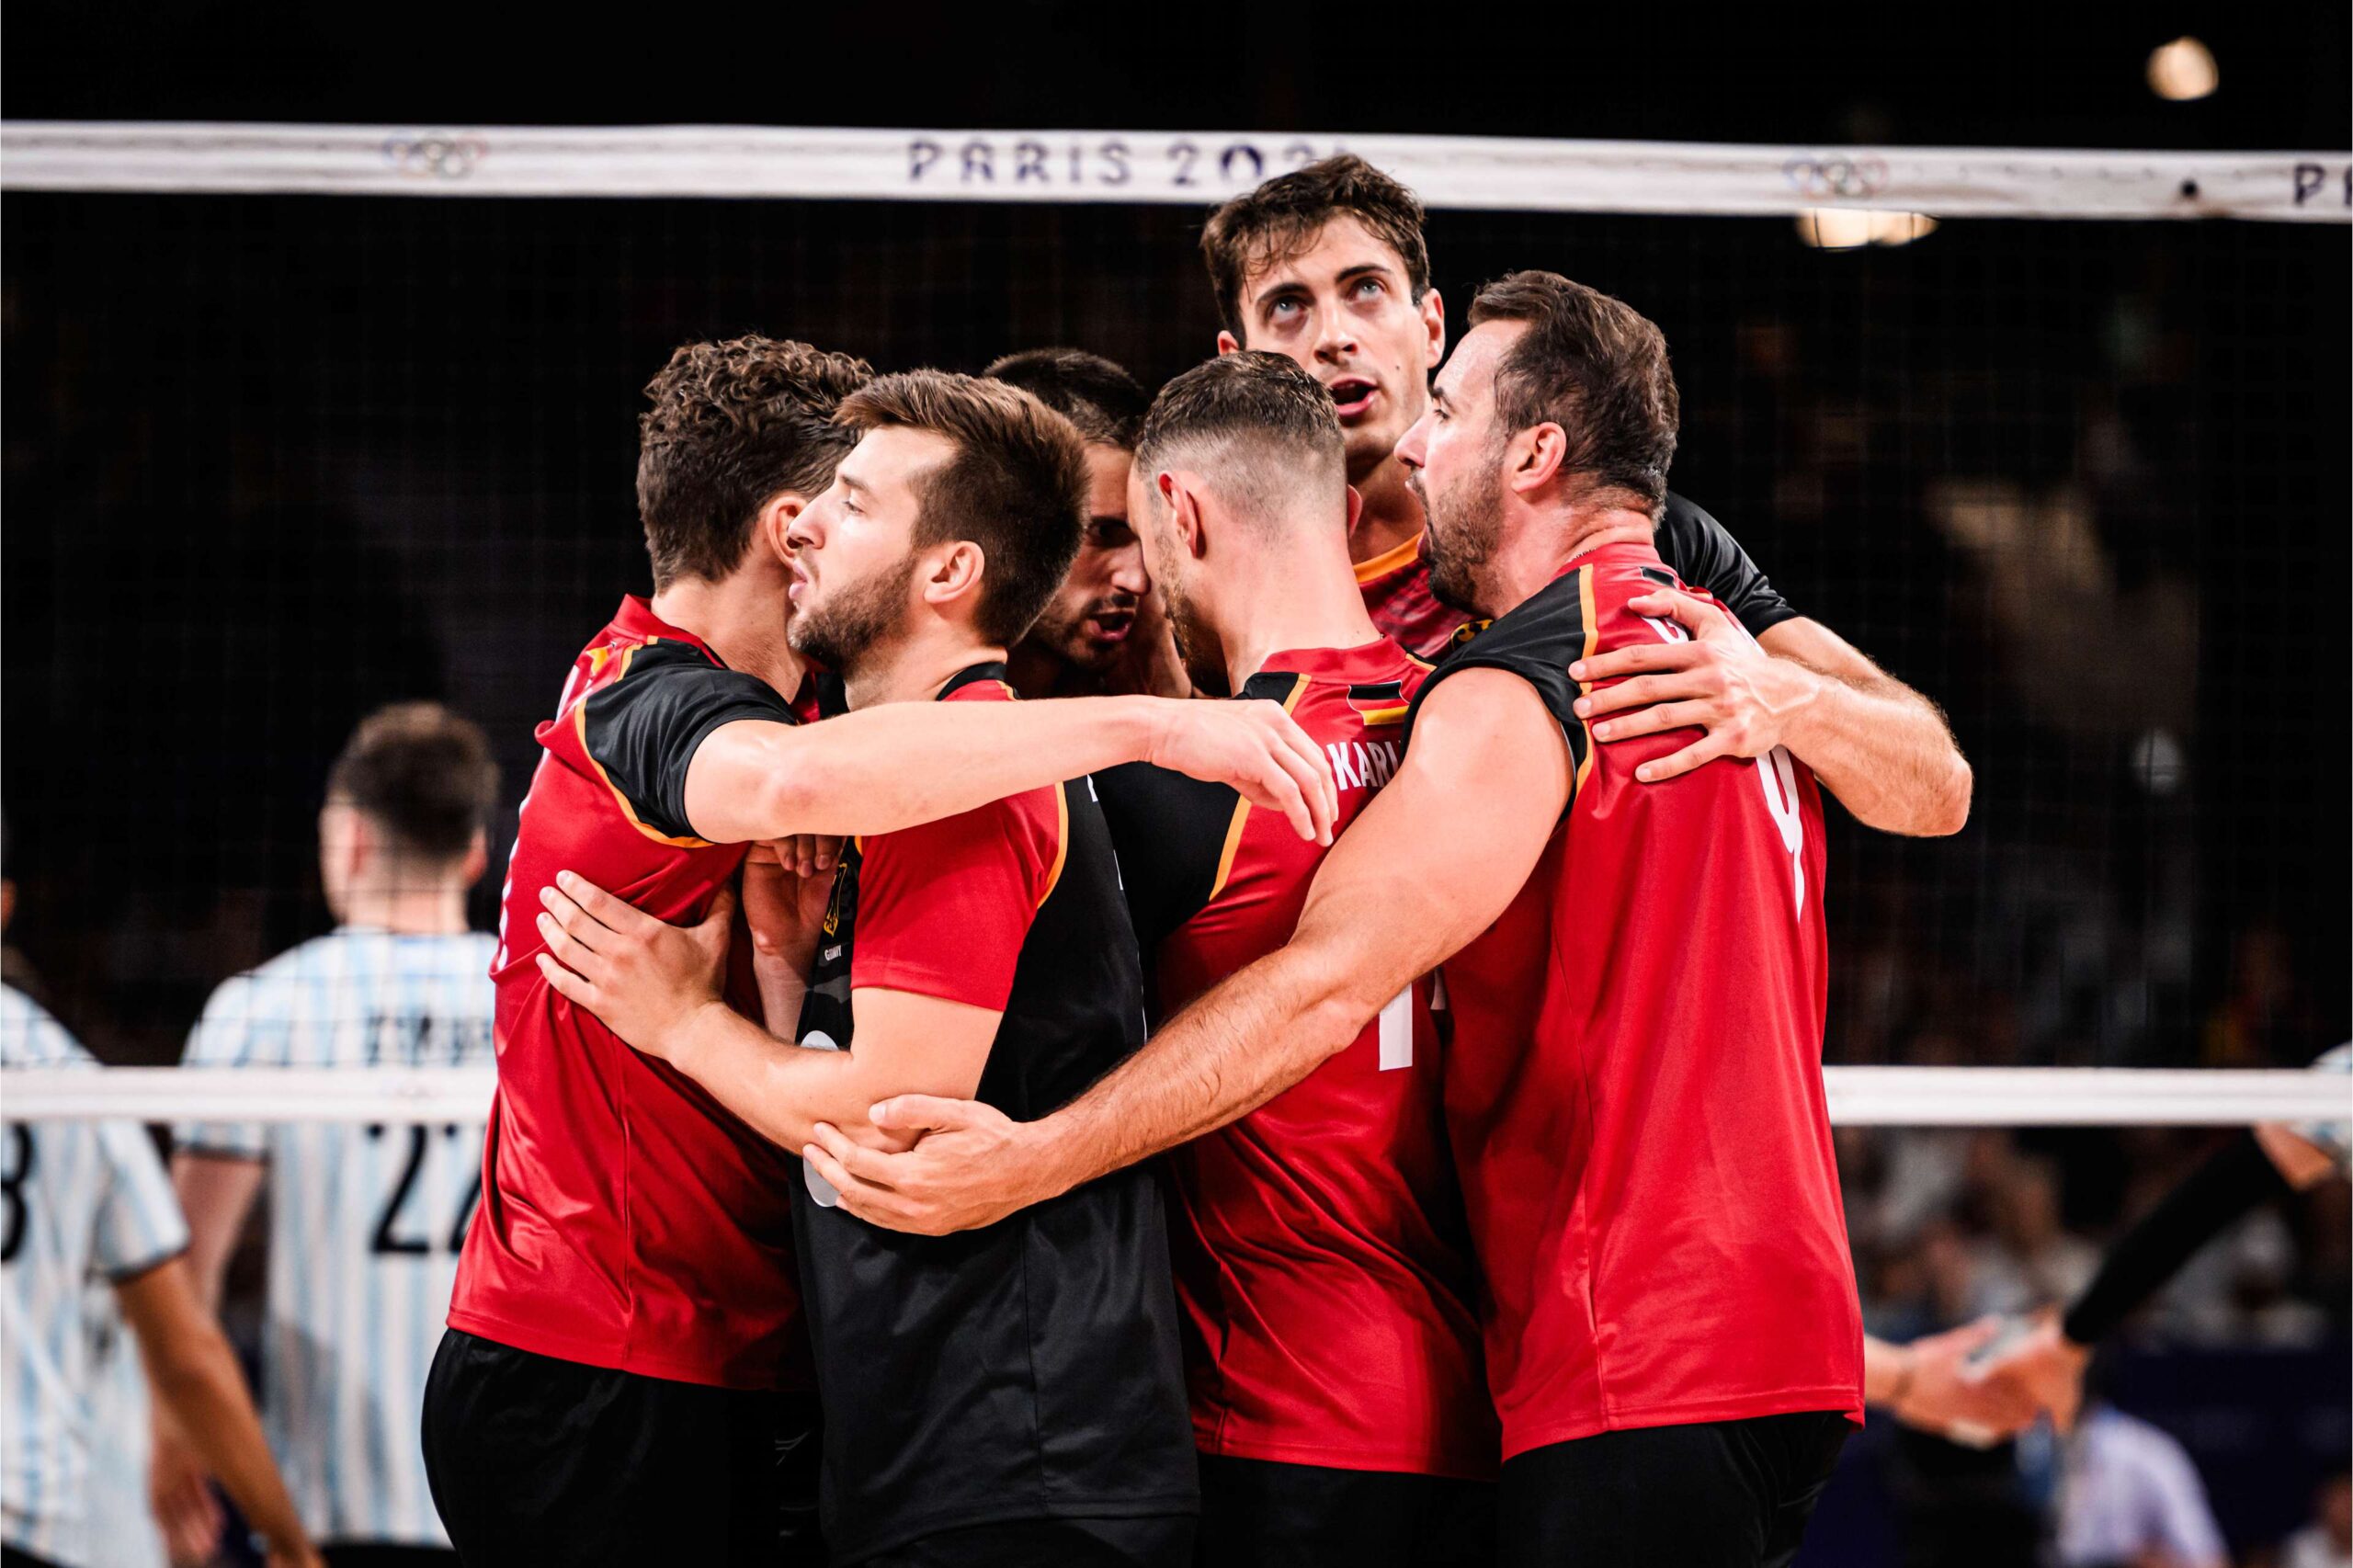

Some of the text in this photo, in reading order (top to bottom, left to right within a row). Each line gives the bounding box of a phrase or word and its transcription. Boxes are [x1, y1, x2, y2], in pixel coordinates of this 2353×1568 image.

[907, 142, 1345, 187] PARIS 202
[2293, 163, 2351, 207] P
